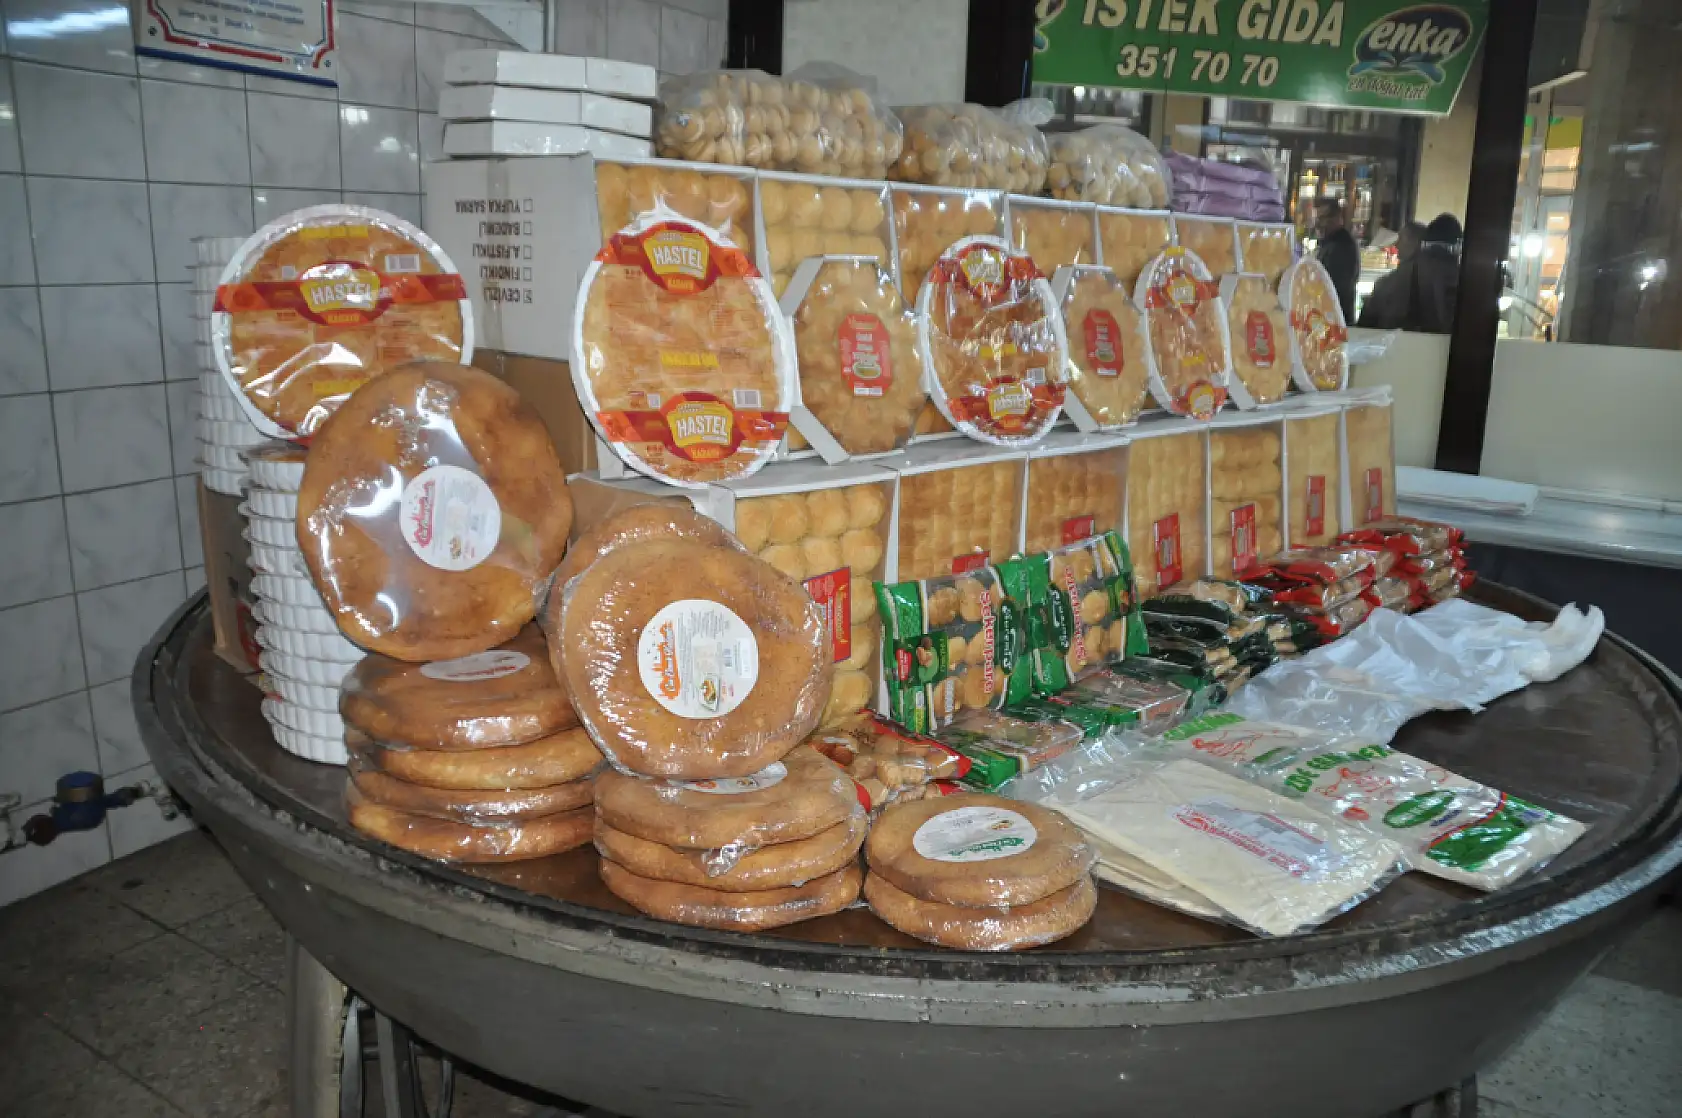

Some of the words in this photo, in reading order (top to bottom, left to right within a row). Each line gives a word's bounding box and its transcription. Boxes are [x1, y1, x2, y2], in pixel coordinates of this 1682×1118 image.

[1236, 0, 1346, 47] GIDA
[1368, 18, 1460, 56] enka
[1115, 43, 1178, 79] 351
[1190, 50, 1229, 83] 70
[1239, 55, 1279, 87] 70
[653, 245, 703, 271] HASTEL
[311, 282, 373, 305] HASTEL
[676, 414, 729, 438] HASTEL
